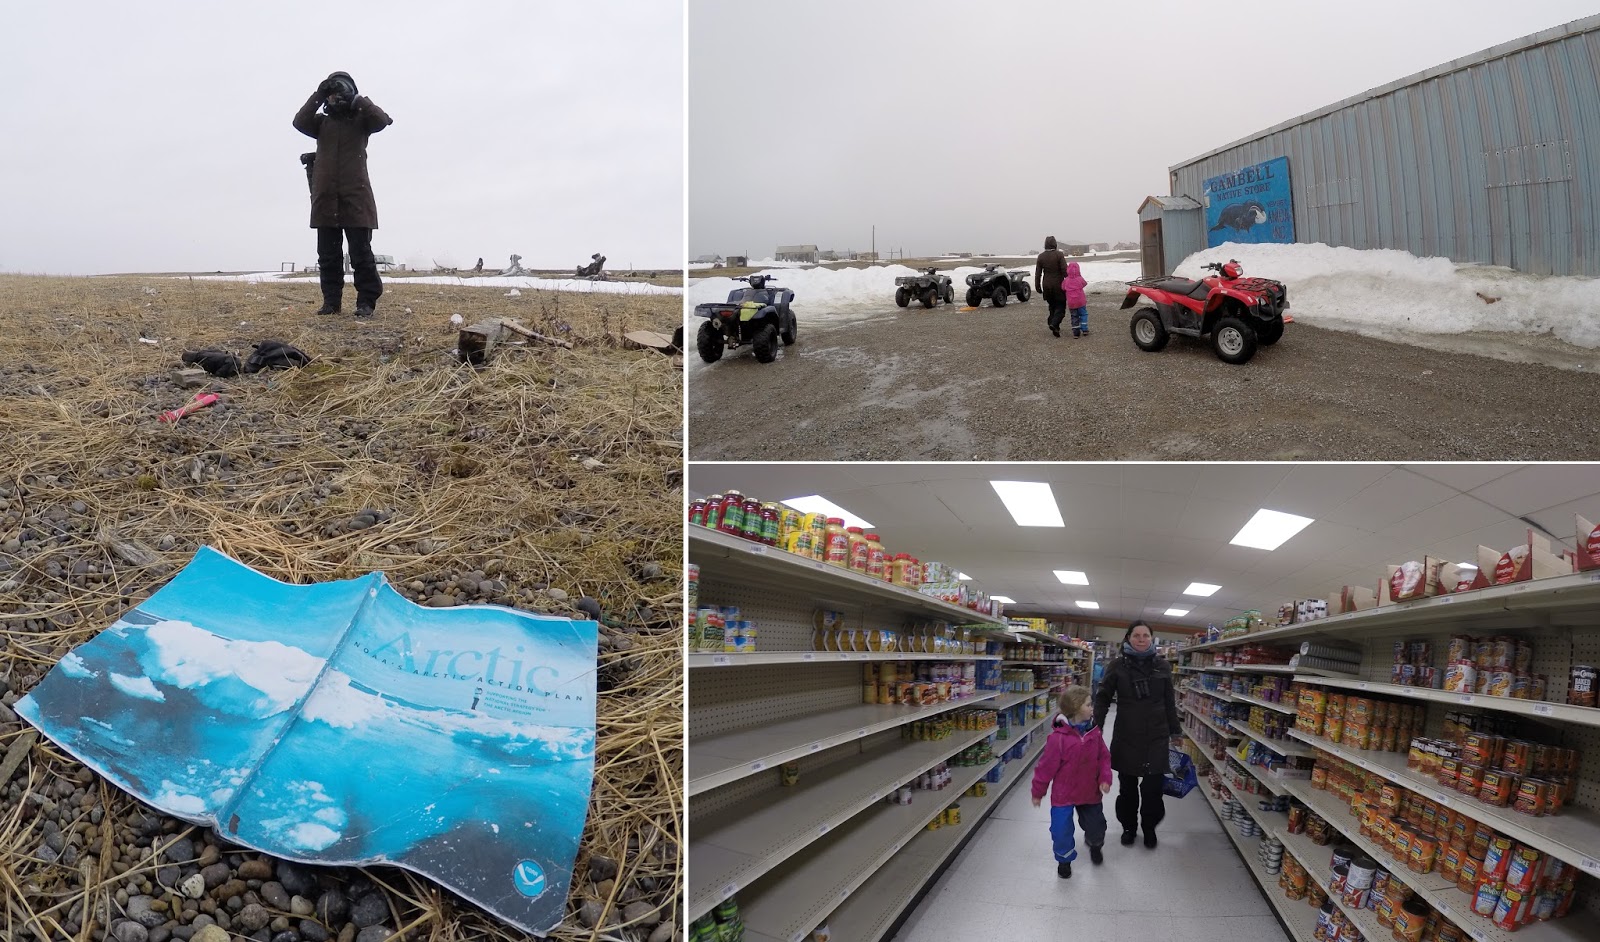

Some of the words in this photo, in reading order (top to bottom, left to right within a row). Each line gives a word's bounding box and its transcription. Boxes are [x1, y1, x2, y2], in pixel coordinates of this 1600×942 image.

[1211, 165, 1274, 192] GAMBELL
[1217, 188, 1242, 202] NATIVE
[1244, 182, 1271, 195] STORE
[366, 631, 559, 697] Arctic
[412, 669, 467, 681] ARCTIC
[477, 676, 534, 694] ACTION
[545, 691, 583, 701] PLAN
